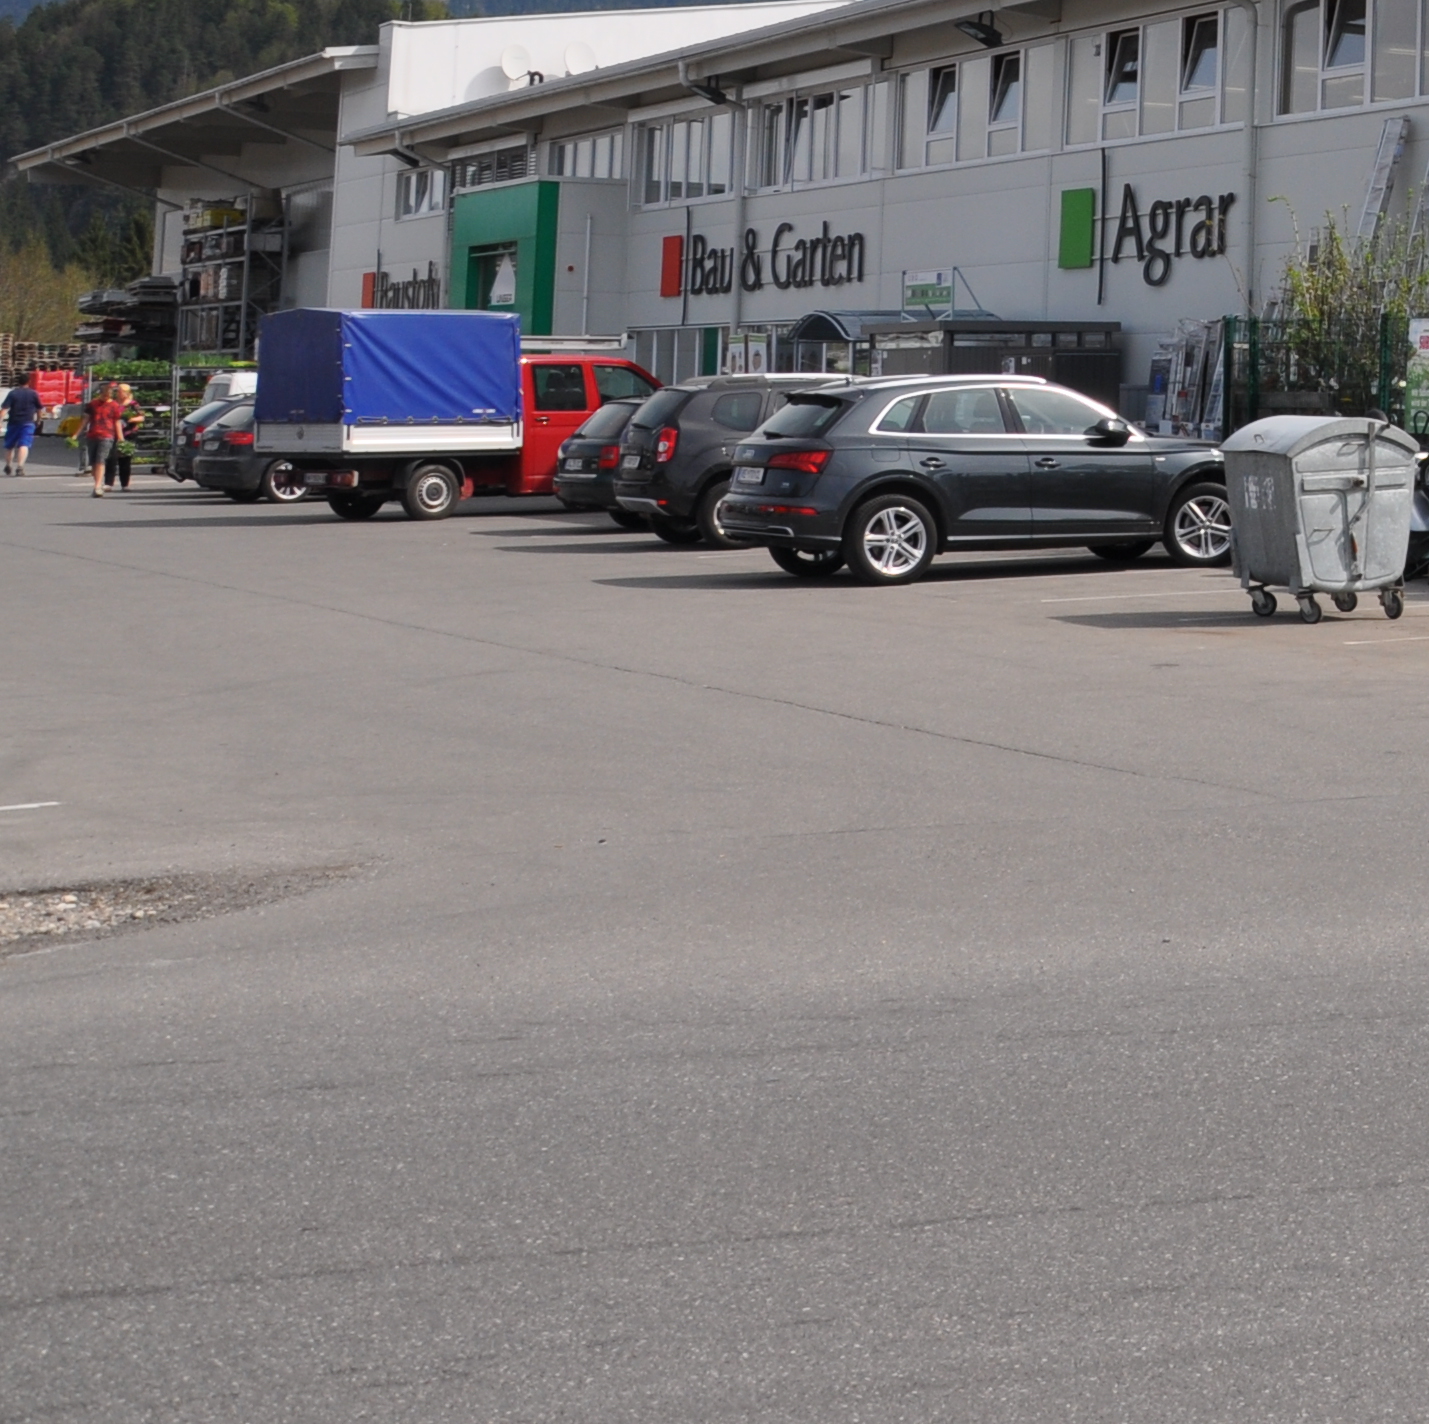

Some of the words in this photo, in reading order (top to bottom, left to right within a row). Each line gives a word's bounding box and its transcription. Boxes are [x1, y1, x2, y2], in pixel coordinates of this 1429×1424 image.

[691, 234, 734, 295] Bau
[740, 228, 763, 292] &
[771, 221, 866, 290] Garten
[1111, 183, 1235, 286] Agrar
